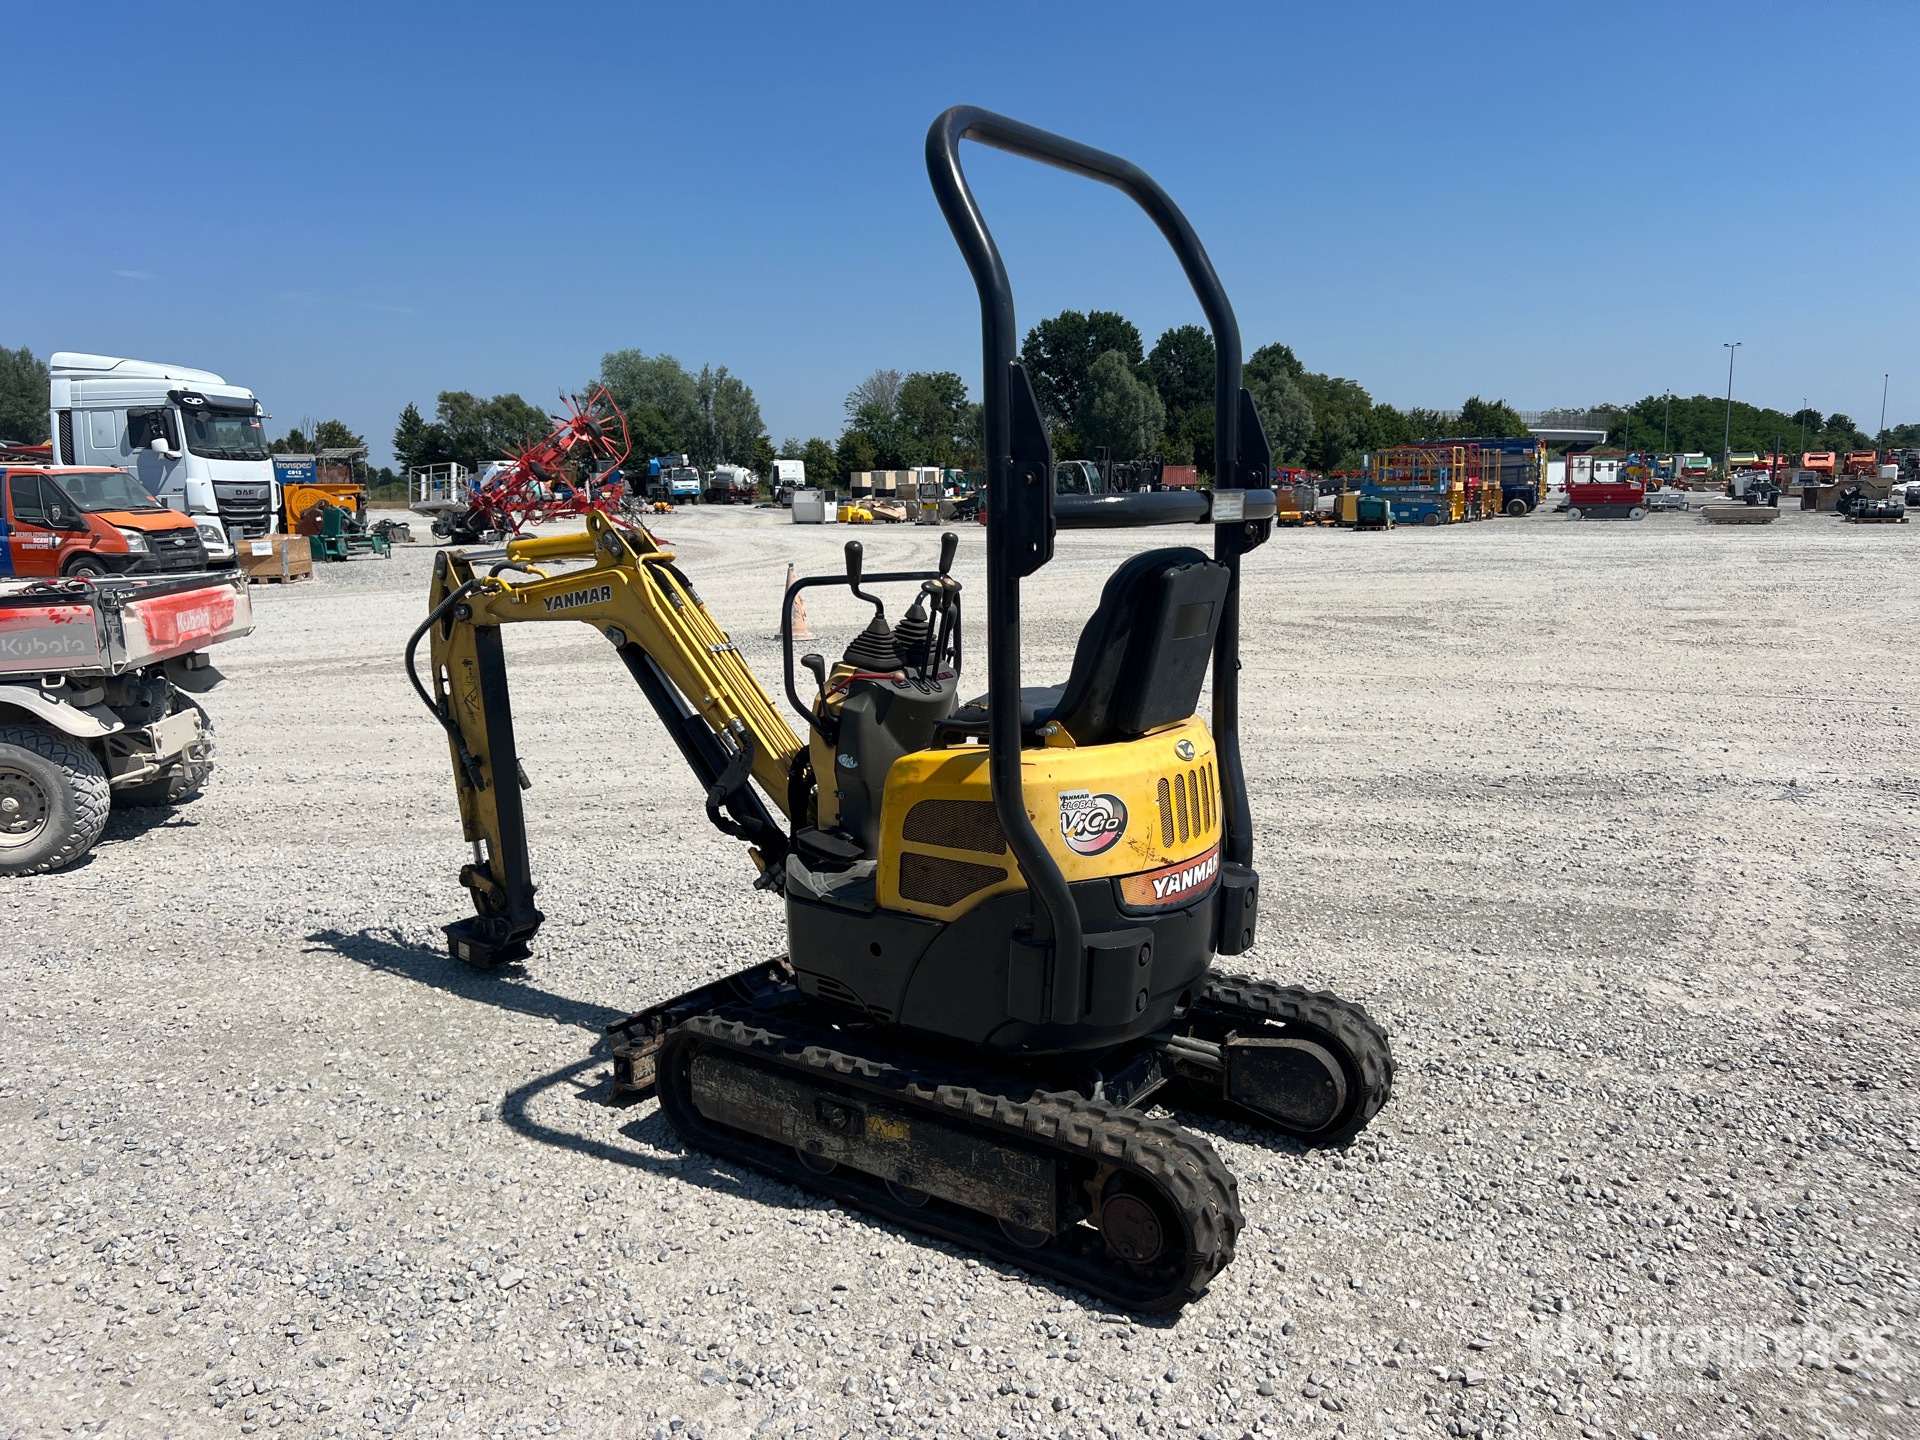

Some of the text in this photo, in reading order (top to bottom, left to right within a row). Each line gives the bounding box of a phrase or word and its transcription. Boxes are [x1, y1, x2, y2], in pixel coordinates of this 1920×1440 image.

[543, 585, 612, 612] YANMAR
[177, 608, 210, 633] Kubota
[1, 635, 86, 656] Kubota
[1059, 793, 1090, 801] YANMAR
[1060, 800, 1098, 811] GLOBAL
[1152, 851, 1219, 900] YANMAR
